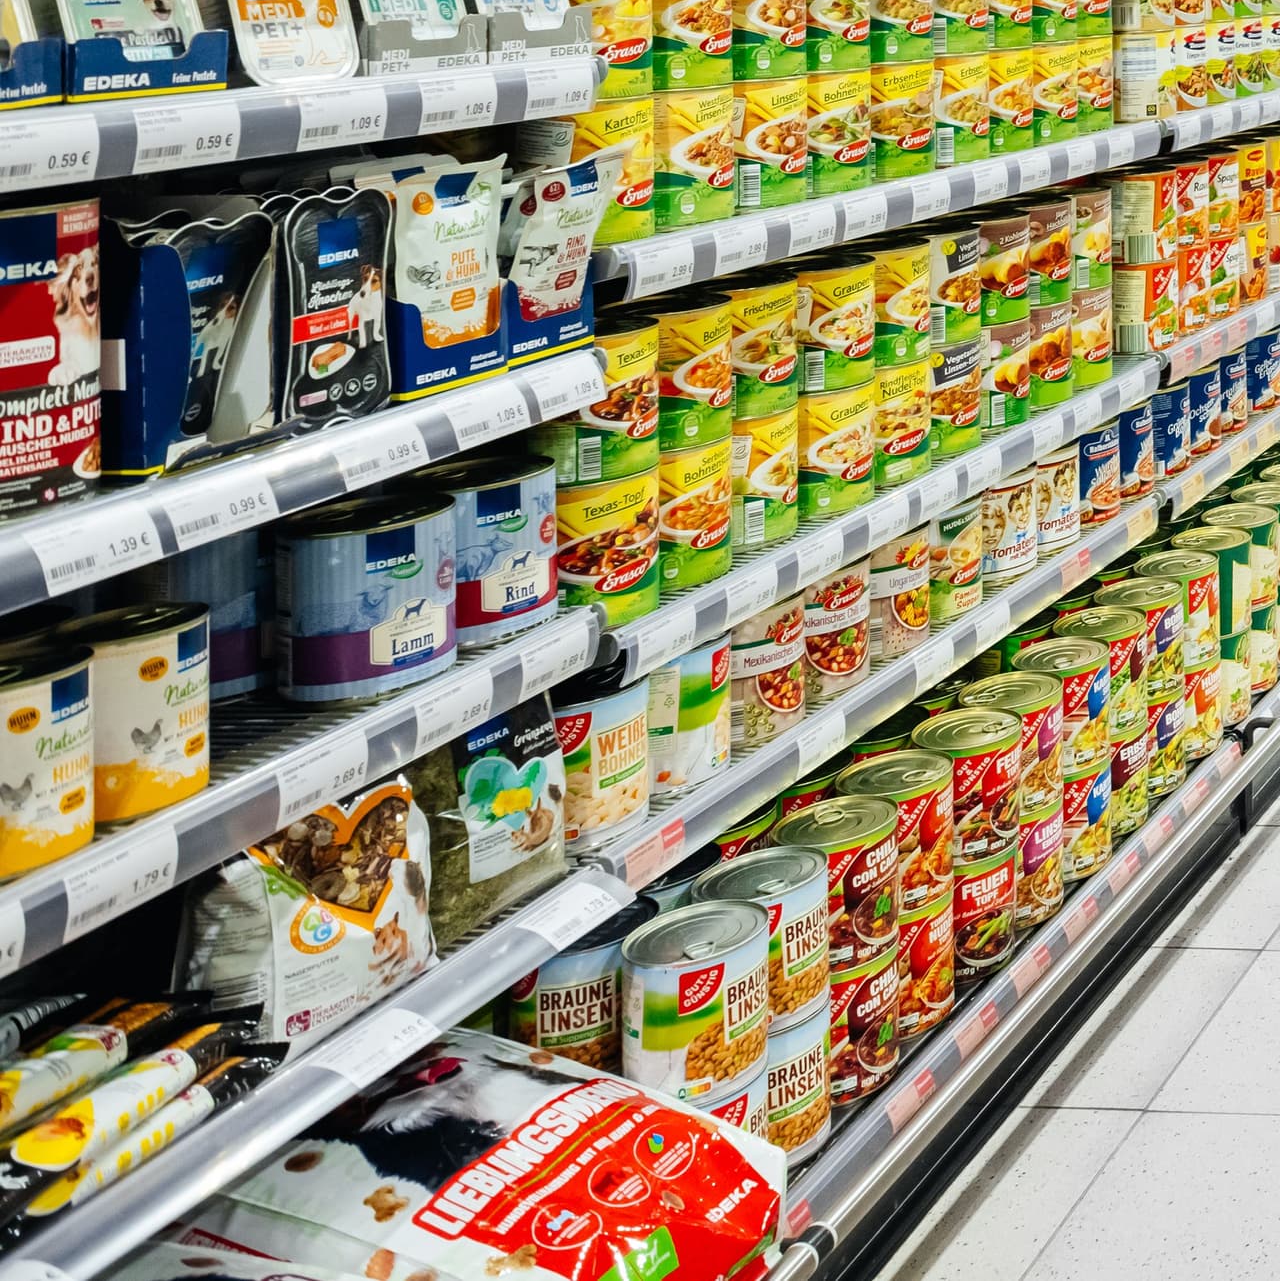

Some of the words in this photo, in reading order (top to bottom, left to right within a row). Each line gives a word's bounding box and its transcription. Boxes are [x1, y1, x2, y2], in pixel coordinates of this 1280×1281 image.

[248, 3, 295, 20] MEDI
[252, 23, 303, 40] PET+
[382, 49, 410, 61] MEDI
[502, 40, 526, 52] MEDI
[550, 45, 590, 57] EDEKA
[604, 42, 645, 62] Erasco
[438, 54, 481, 67] EDEKA
[502, 51, 528, 62] PET+
[172, 72, 193, 83] Feine
[194, 69, 217, 82] Pastete
[382, 60, 410, 74] PET+
[82, 74, 150, 90] EDEKA
[566, 234, 586, 251] RIND
[318, 249, 359, 265] EDEKA
[451, 249, 476, 265] PUTE
[566, 246, 586, 263] HUHN
[0, 259, 58, 279] DEKA
[456, 261, 480, 279] HUHN
[513, 337, 548, 353] EDEKA
[416, 365, 458, 383] EDEKA
[583, 488, 645, 519] Texas-Topf
[476, 509, 522, 525] EDEKA
[366, 553, 416, 573] EDEKA
[603, 561, 648, 593] Erasco
[506, 581, 535, 605] Rind
[392, 631, 434, 655] Lamm
[141, 659, 166, 673] HUHN
[468, 727, 509, 751] EDEKA
[599, 736, 646, 777] BOHNEN
[958, 756, 991, 793] GÜNSTIG
[866, 835, 896, 868] CHILI
[852, 869, 879, 888] CON
[962, 868, 1009, 900] FEUER
[975, 887, 998, 906] TOPF
[539, 979, 613, 1010] BRAUNE
[683, 969, 718, 1008] GÜNSTIG
[539, 1001, 613, 1035] LINSEN
[769, 1045, 822, 1088] BRAUNE
[769, 1069, 822, 1109] LINSEN
